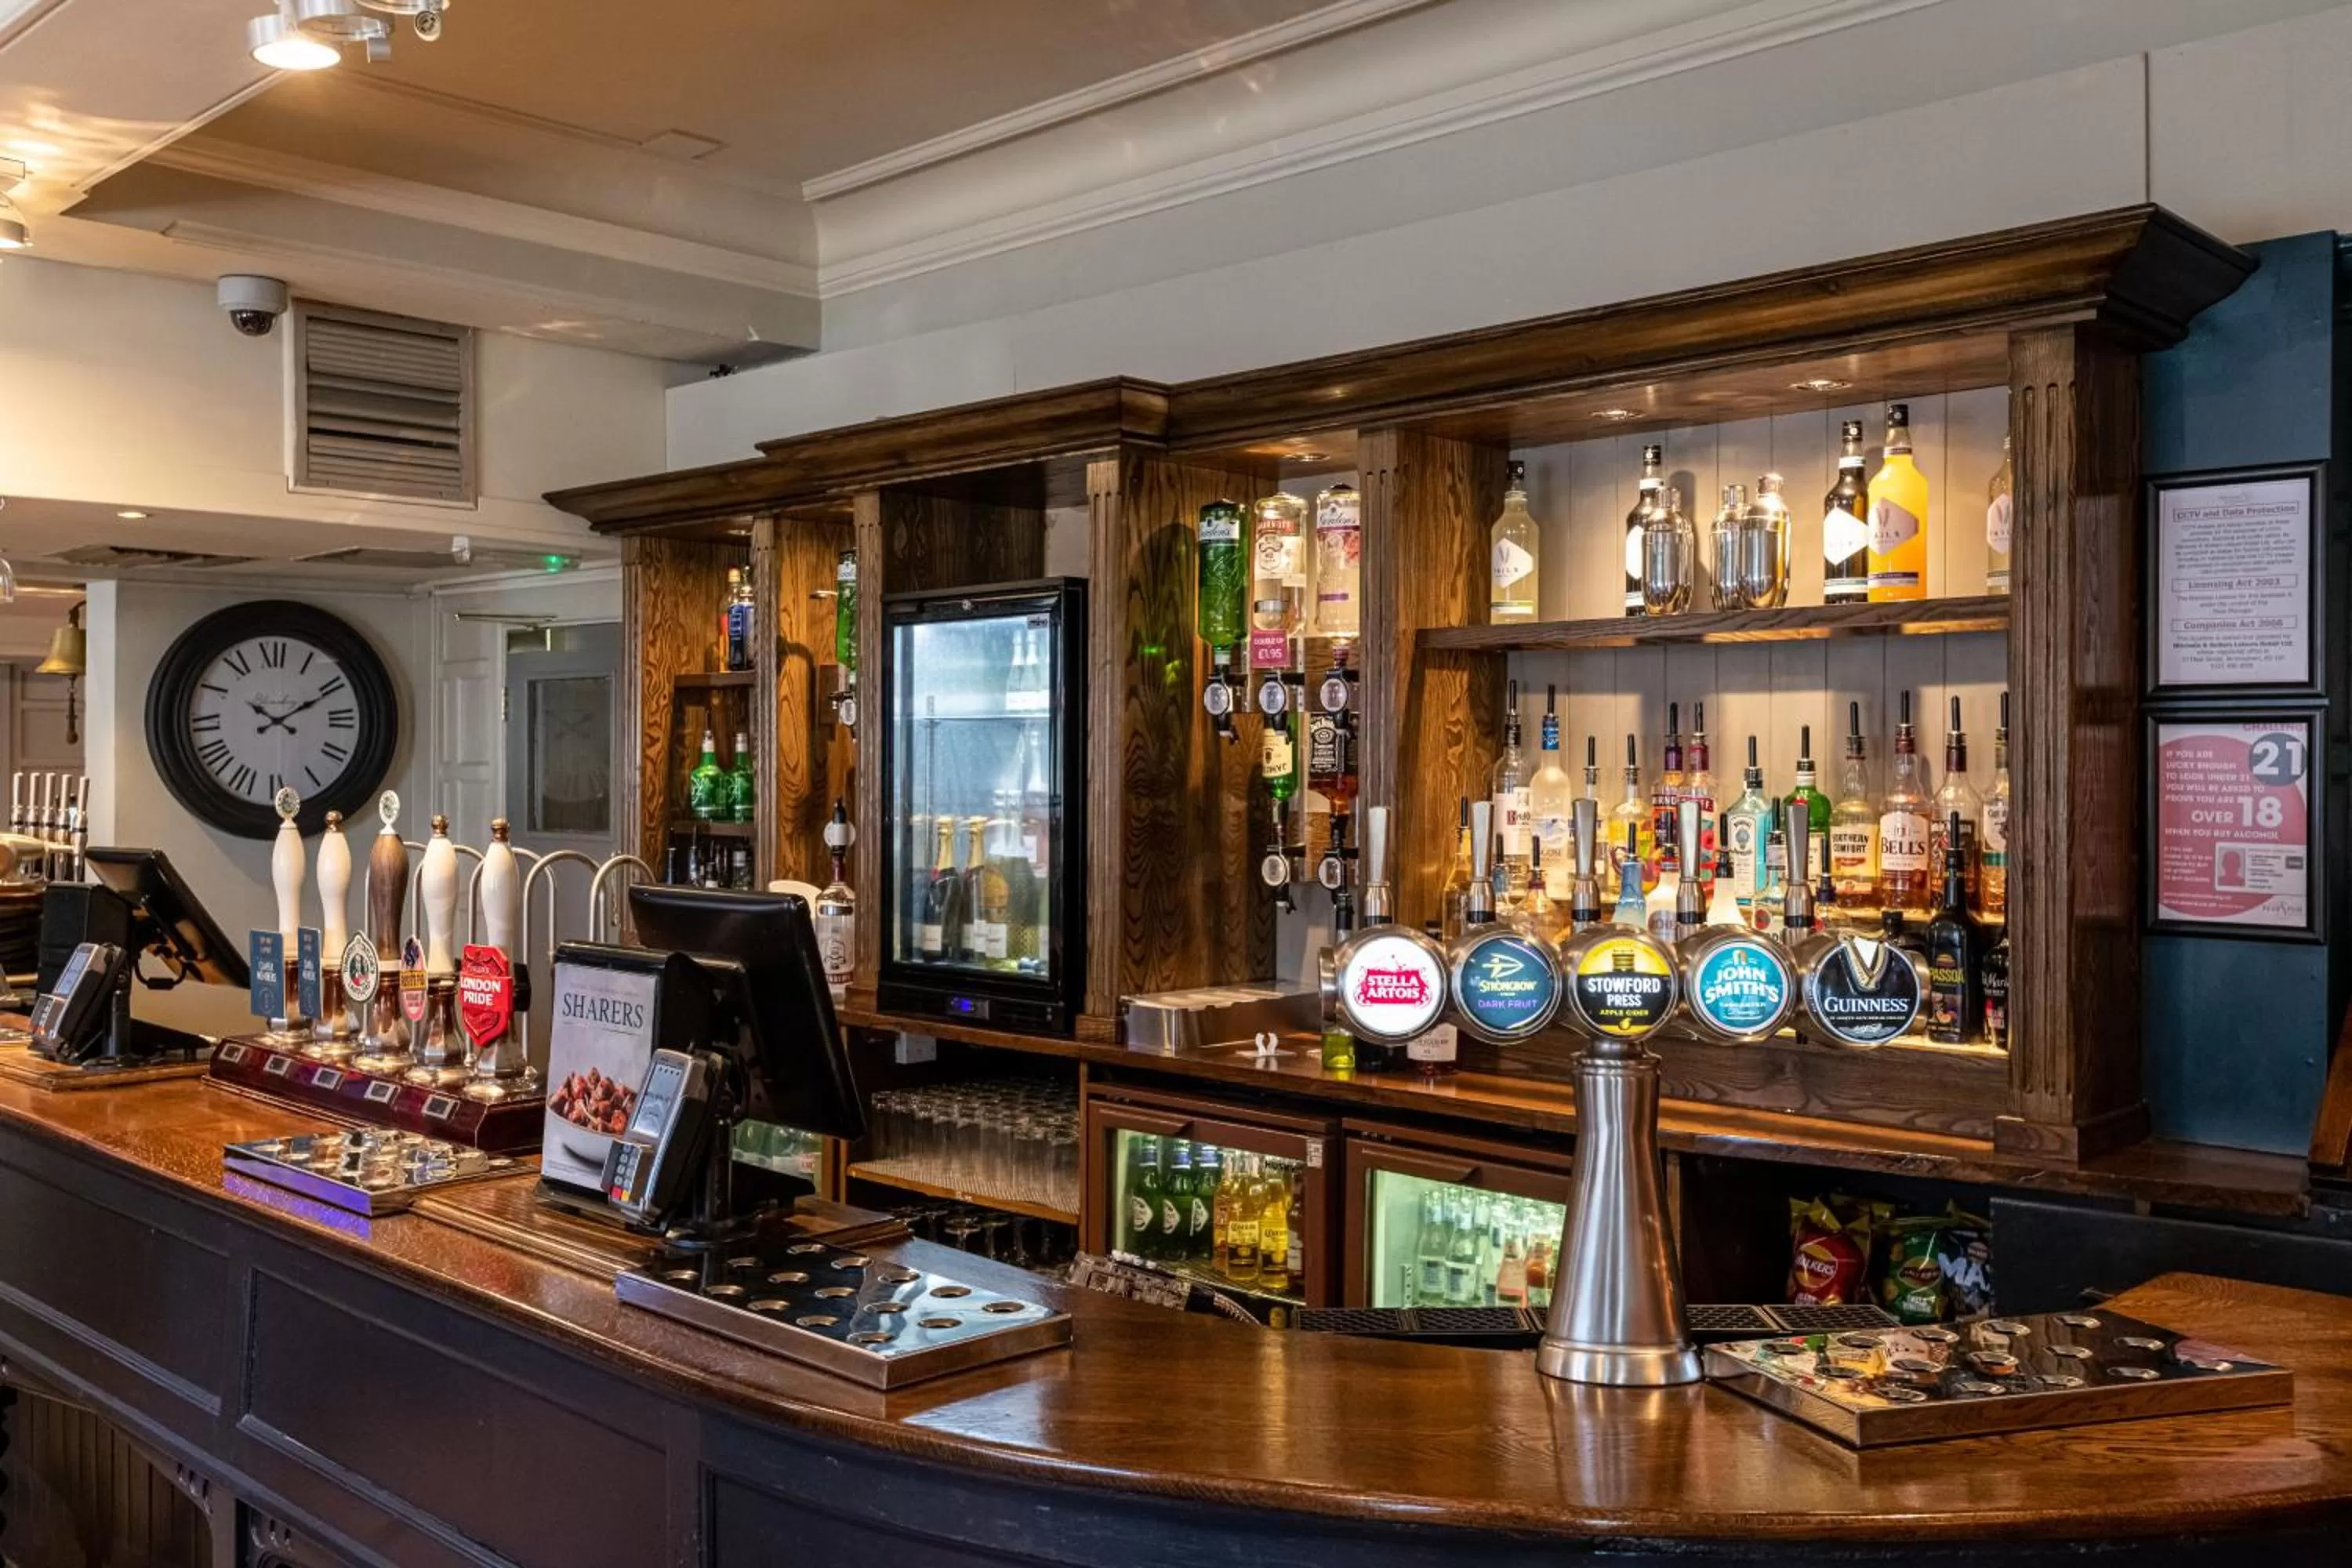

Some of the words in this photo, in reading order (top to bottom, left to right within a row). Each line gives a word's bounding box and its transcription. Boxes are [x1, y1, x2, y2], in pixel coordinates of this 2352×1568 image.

[2203, 510, 2220, 518] and
[2247, 505, 2297, 516] Protection
[2188, 579, 2234, 590] Licensing
[2236, 578, 2252, 587] Act
[2183, 620, 2237, 631] Companies
[2239, 619, 2256, 629] Act
[2176, 750, 2194, 759] YOU
[2197, 750, 2213, 759] ARE
[2252, 741, 2303, 775] 21
[2207, 773, 2238, 782] UNDER
[2221, 785, 2251, 793] ASKED
[2196, 795, 2215, 804] YOU
[2190, 811, 2234, 823] OVER
[2237, 795, 2284, 828] 18
[2213, 829, 2231, 838] BUY
[2234, 829, 2279, 840] ALCOHOL
[1882, 837, 1926, 855] BELL'S
[1367, 975, 1419, 987] STELLA
[1714, 966, 1767, 984] JOHN
[460, 978, 502, 993] LONDON
[1588, 977, 1661, 993] STOWFORD
[463, 990, 494, 1006] PRIDE
[1367, 986, 1421, 1000] ARTOIS
[1705, 982, 1779, 1004] SMITH'S
[1478, 1000, 1506, 1009] DARK
[1508, 999, 1538, 1009] FRUIT
[1606, 994, 1642, 1006] PRESS
[1824, 996, 1909, 1013] GUINNESS
[562, 993, 644, 1029] SHARERS
